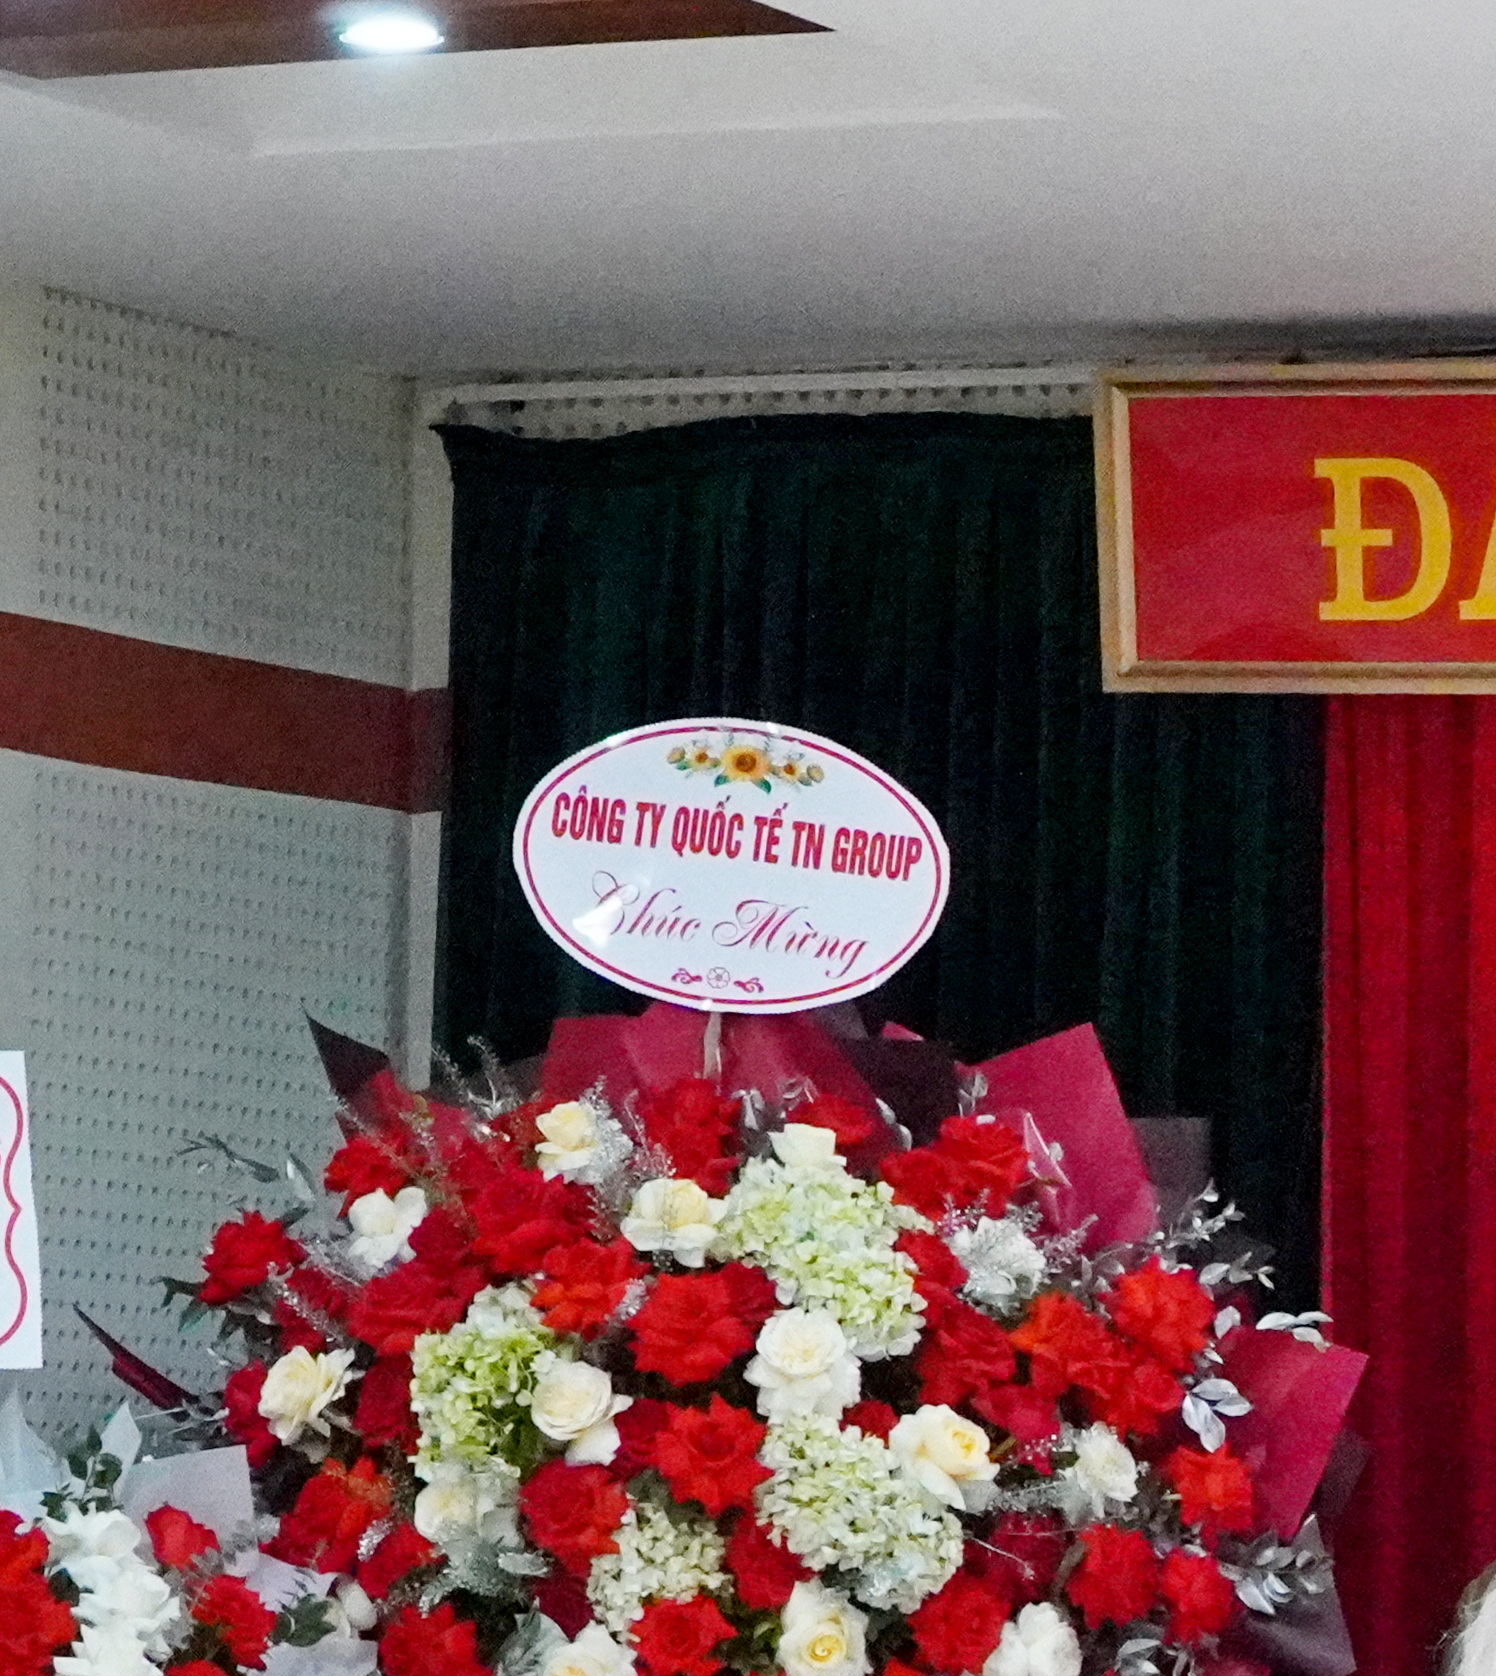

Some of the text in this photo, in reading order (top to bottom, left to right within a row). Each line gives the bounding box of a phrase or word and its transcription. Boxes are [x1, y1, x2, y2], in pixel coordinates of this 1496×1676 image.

[551, 785, 923, 881] CÔNG TY QUỐC TẾ TN GROUP
[711, 899, 870, 979] Mừng
